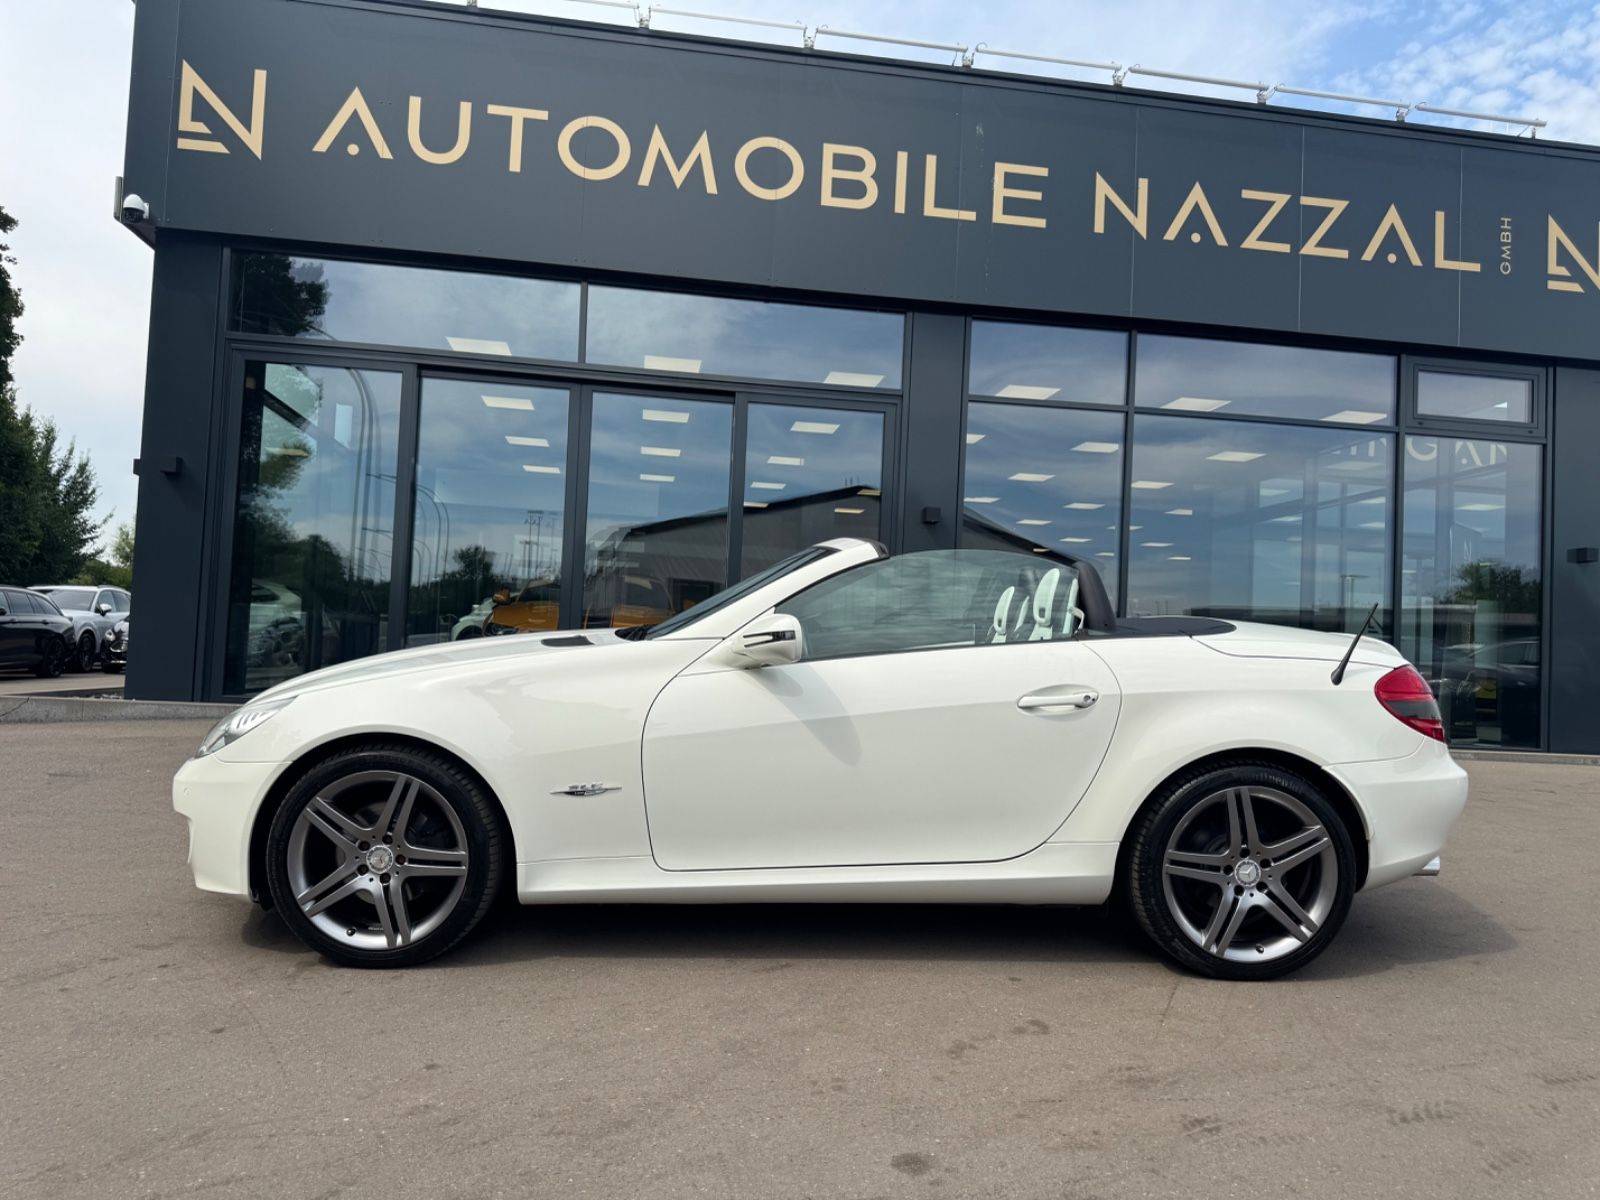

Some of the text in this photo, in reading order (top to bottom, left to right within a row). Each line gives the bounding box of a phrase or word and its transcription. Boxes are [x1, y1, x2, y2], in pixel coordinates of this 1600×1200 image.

[311, 86, 1481, 273] AUTOMOBILE NAZZAL
[1499, 216, 1513, 276] GMBH
